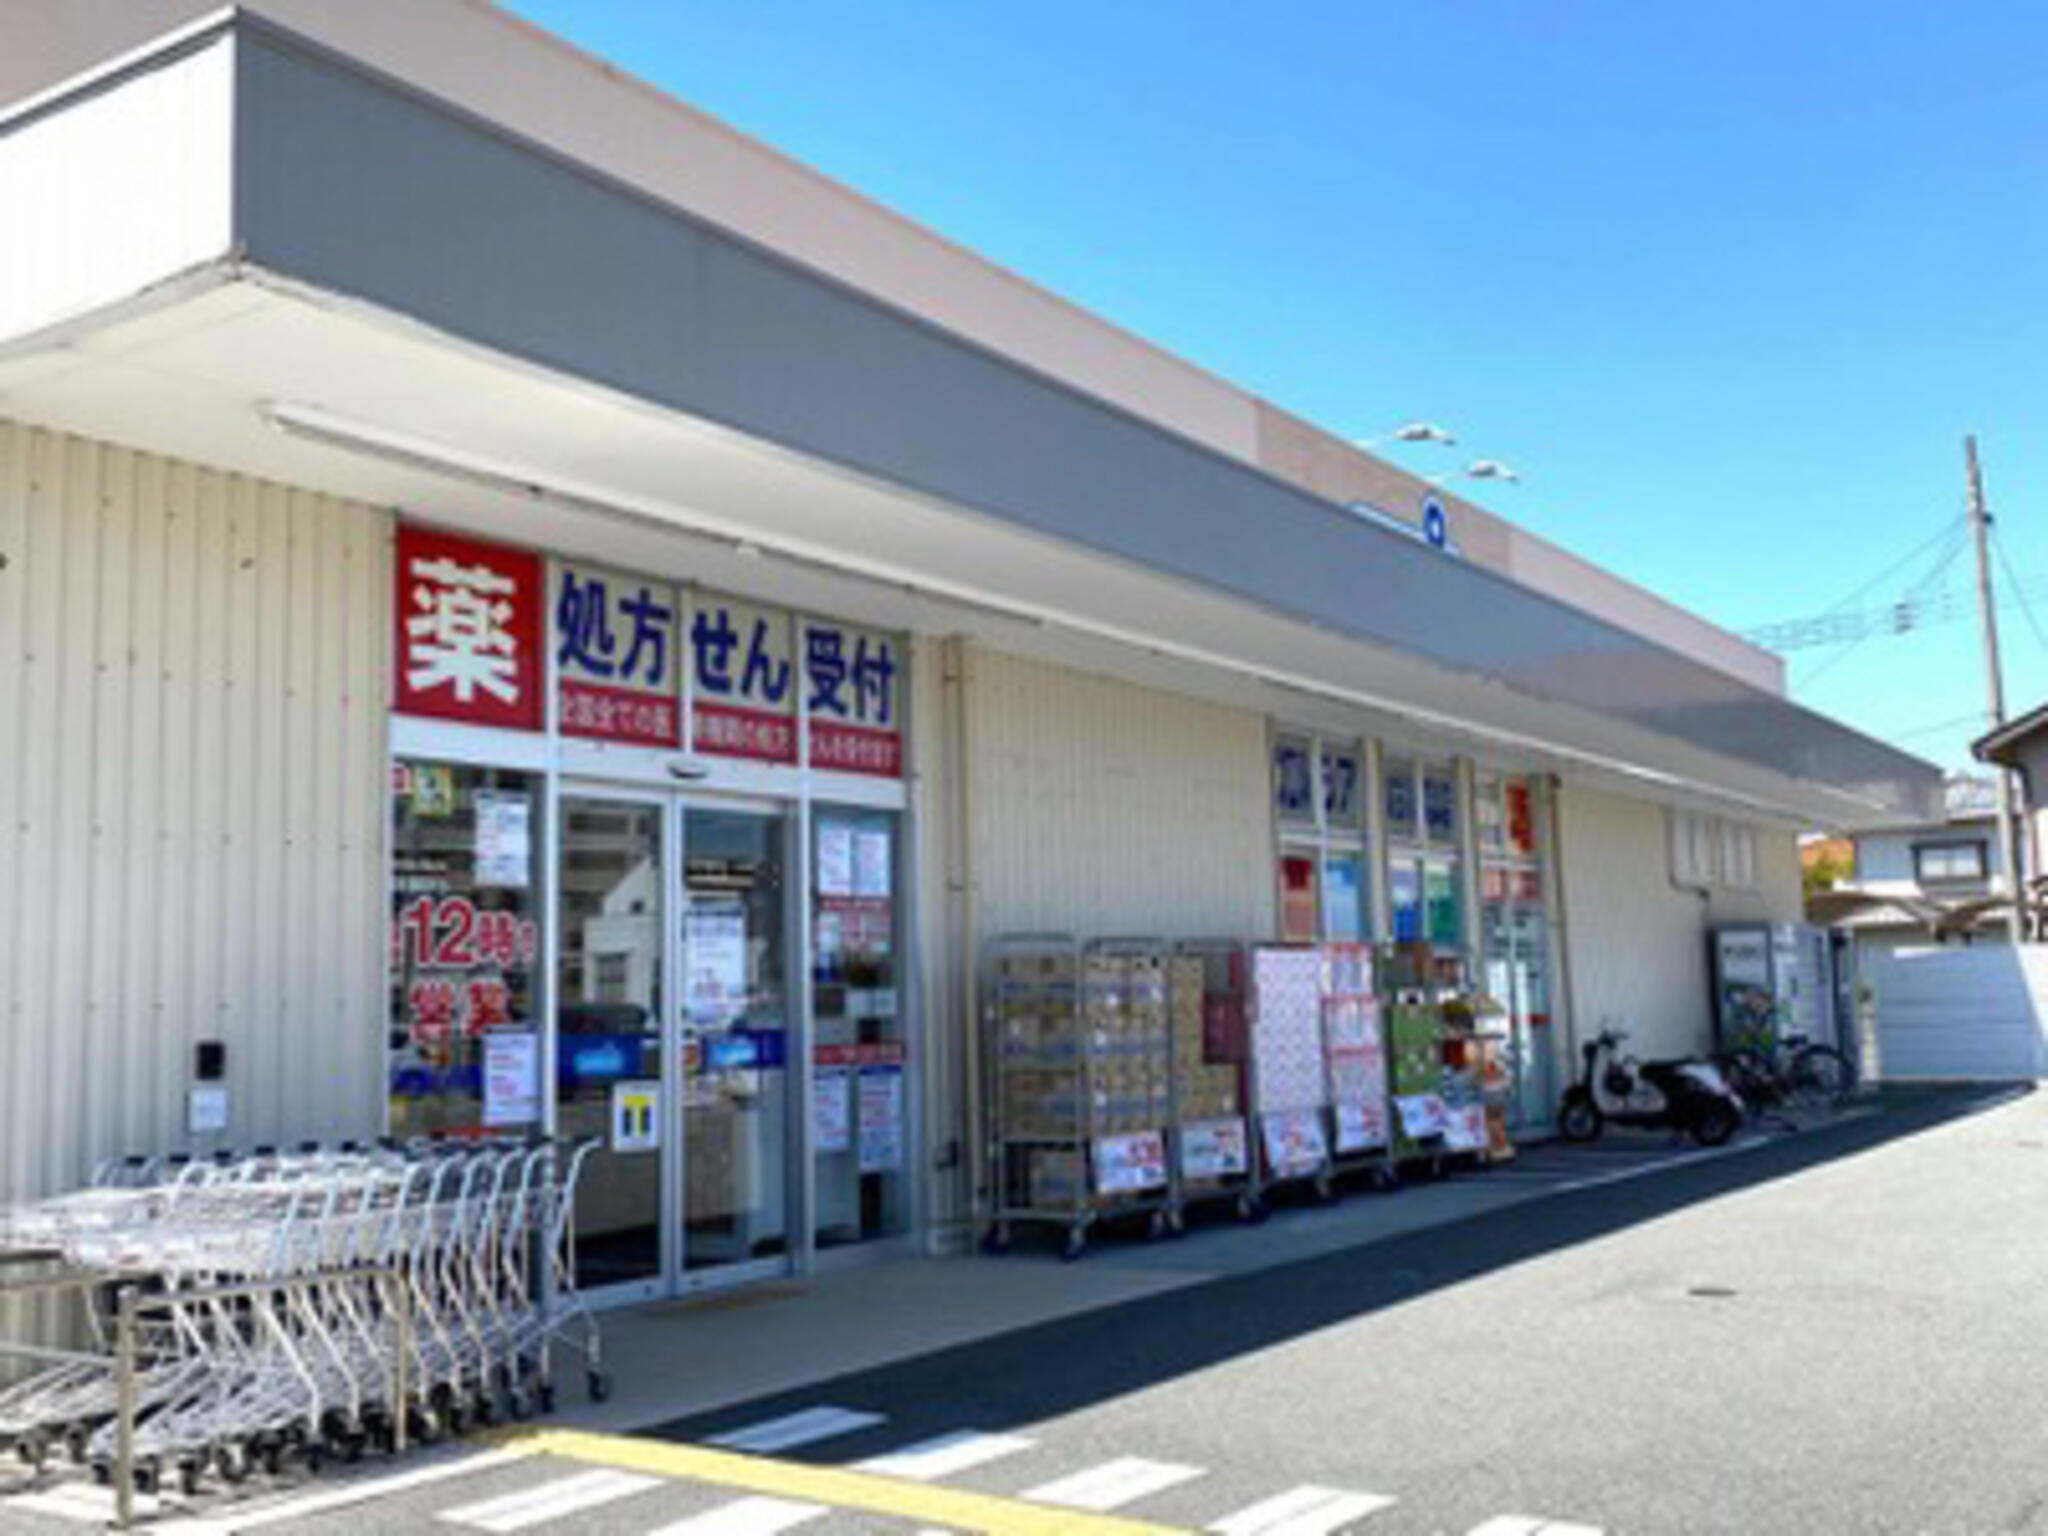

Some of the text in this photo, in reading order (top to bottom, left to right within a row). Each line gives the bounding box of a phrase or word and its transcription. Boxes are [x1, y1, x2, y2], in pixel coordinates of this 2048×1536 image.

[407, 557, 520, 705] 薬
[557, 570, 896, 724] 処方せん受付
